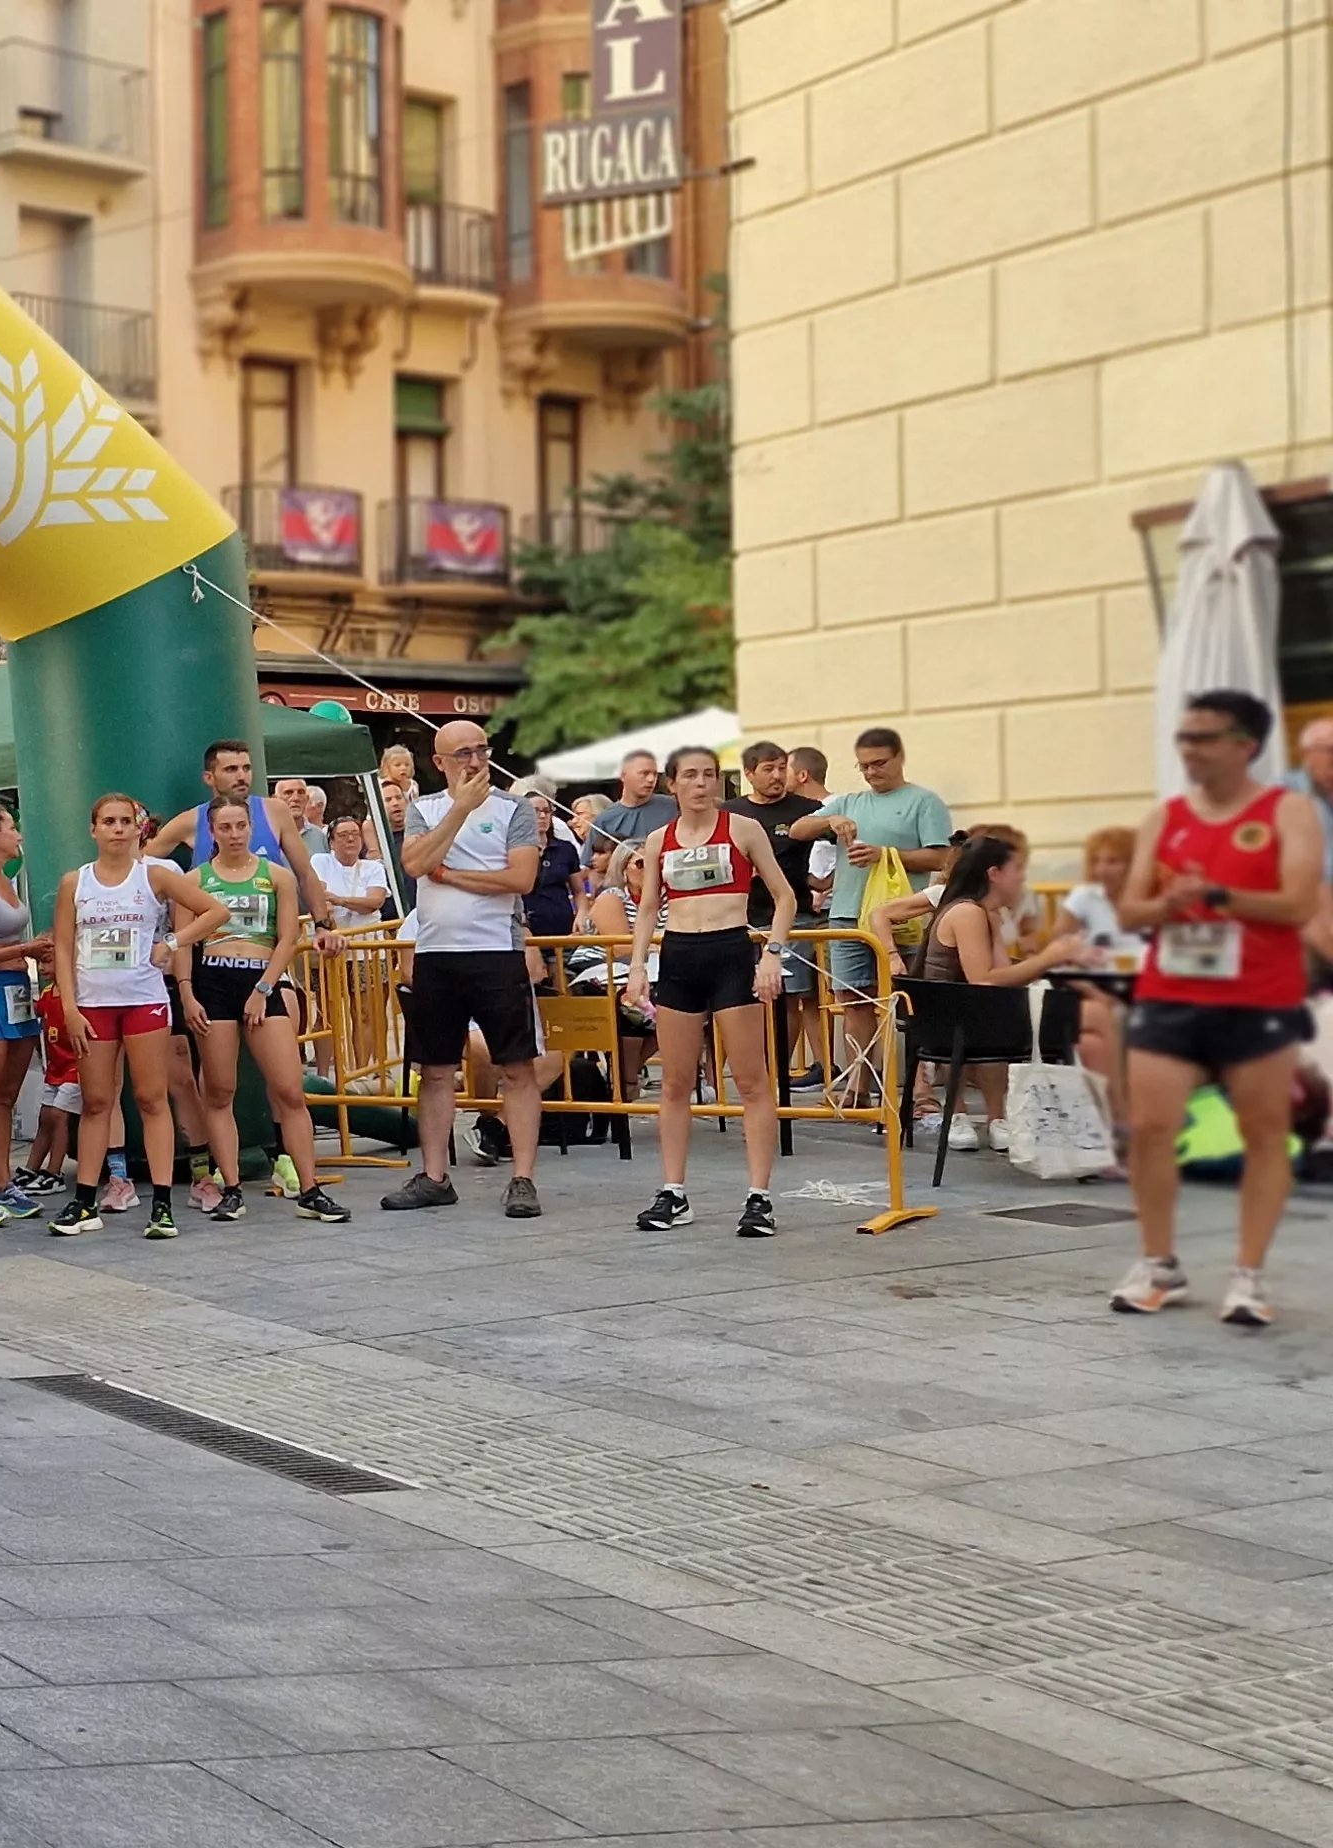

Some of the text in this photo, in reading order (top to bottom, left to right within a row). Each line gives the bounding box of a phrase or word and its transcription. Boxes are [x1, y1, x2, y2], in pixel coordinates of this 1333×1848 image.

[544, 117, 678, 196] RUGACA
[453, 694, 501, 713] OSC
[683, 846, 709, 862] 28
[227, 896, 251, 908] 23
[113, 913, 145, 923] ZUERA
[99, 929, 121, 943] 21
